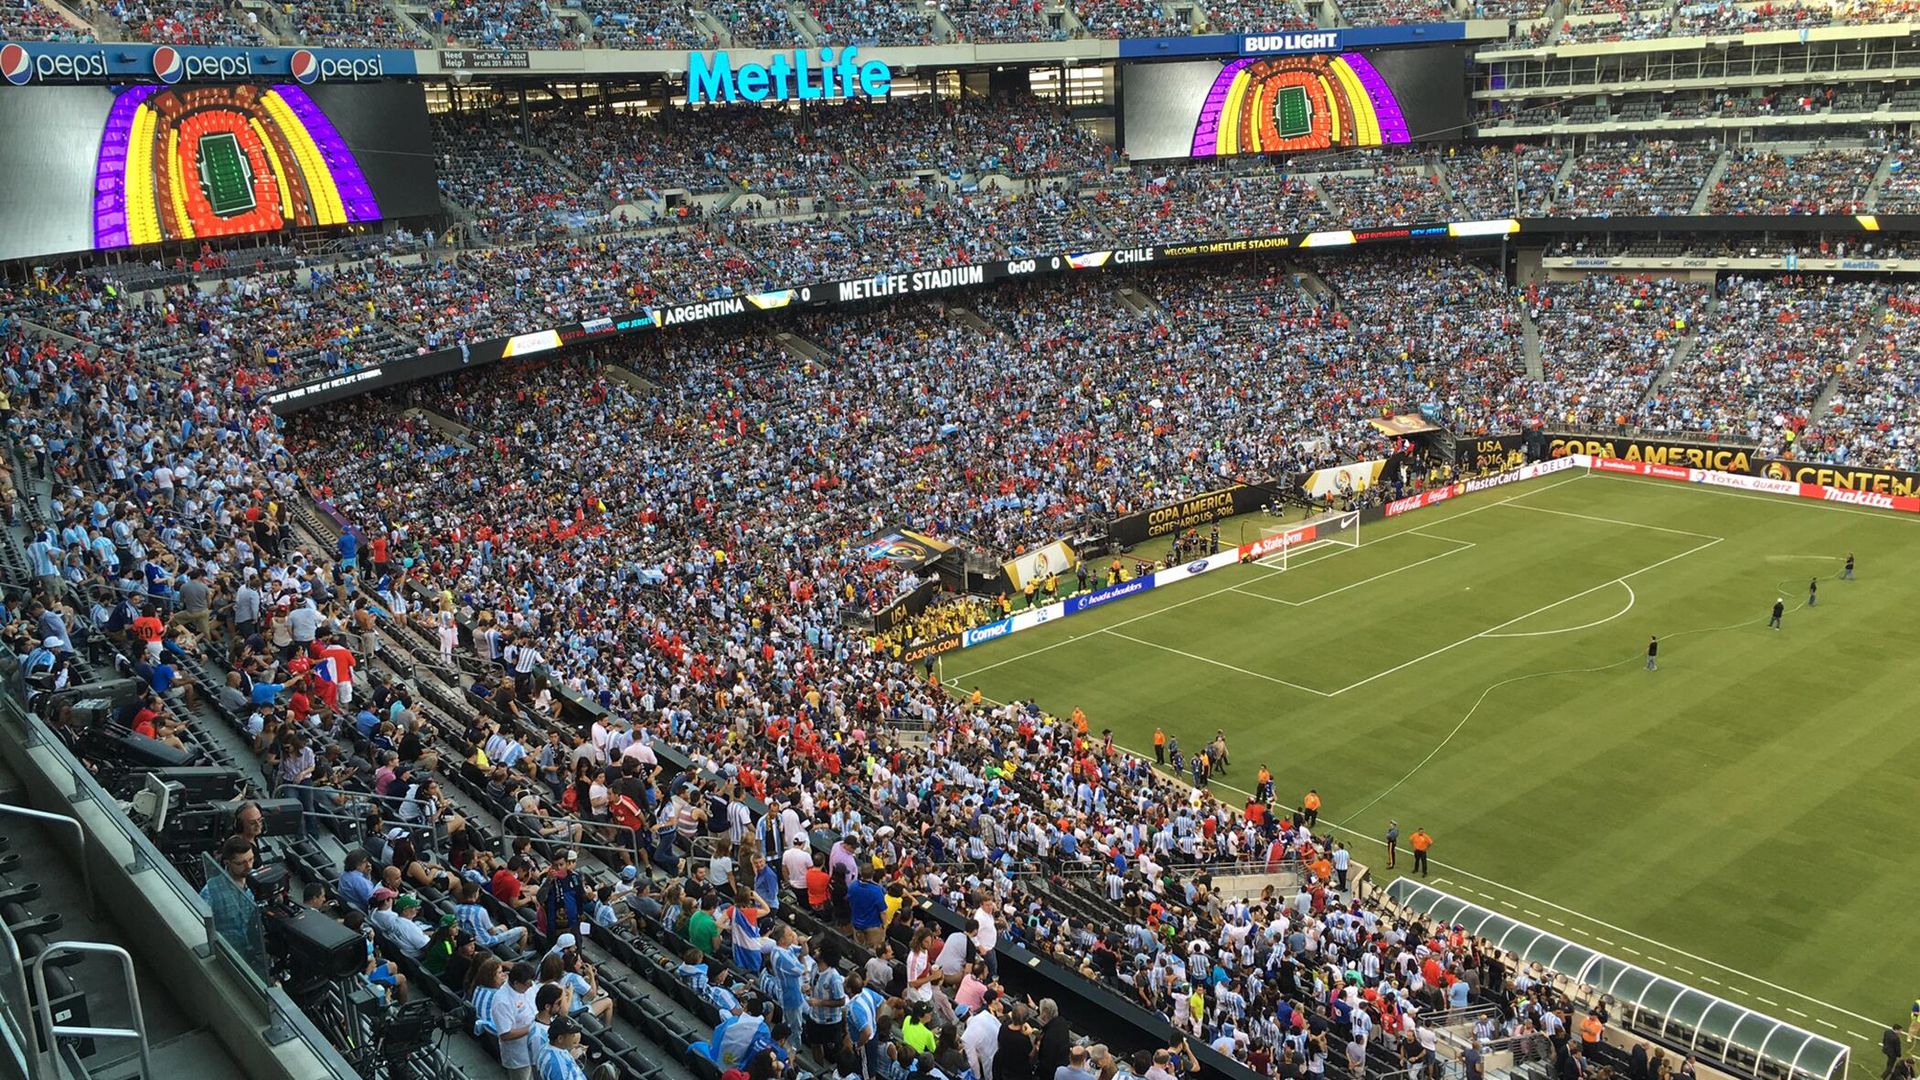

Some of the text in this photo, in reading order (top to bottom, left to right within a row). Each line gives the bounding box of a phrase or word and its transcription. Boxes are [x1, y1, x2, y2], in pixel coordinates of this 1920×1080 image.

[1245, 33, 1337, 52] BUD LIGHT
[37, 50, 109, 82] pepsi
[186, 51, 252, 81] pepsi
[321, 54, 383, 82] pepsi
[445, 59, 466, 68] Help?
[688, 45, 892, 104] MetLife
[1425, 227, 1447, 235] JERSEY
[1114, 248, 1154, 264] CHILE
[1164, 238, 1289, 256] WELCOME TO METLIFE STADIUM
[1008, 259, 1036, 275] 0:00
[1051, 256, 1060, 270] 0
[1842, 260, 1880, 270] MetLife
[839, 265, 983, 301] METLIFE STADIUM
[801, 286, 811, 302] 0
[665, 299, 745, 327] ARGENTINA
[617, 319, 630, 330] NEW
[1477, 440, 1502, 453] USA
[1542, 457, 1575, 474] DELTA
[1624, 444, 1750, 472] AMERICA
[1466, 470, 1520, 493] MasterCard
[1711, 472, 1793, 493] TOTAL QUARTZ
[1796, 467, 1920, 496] CENTEN
[1149, 492, 1233, 525] COPA AMERICA
[891, 603, 907, 625] USA
[970, 620, 1008, 643] Comex
[905, 638, 959, 662] CA2016.COM
